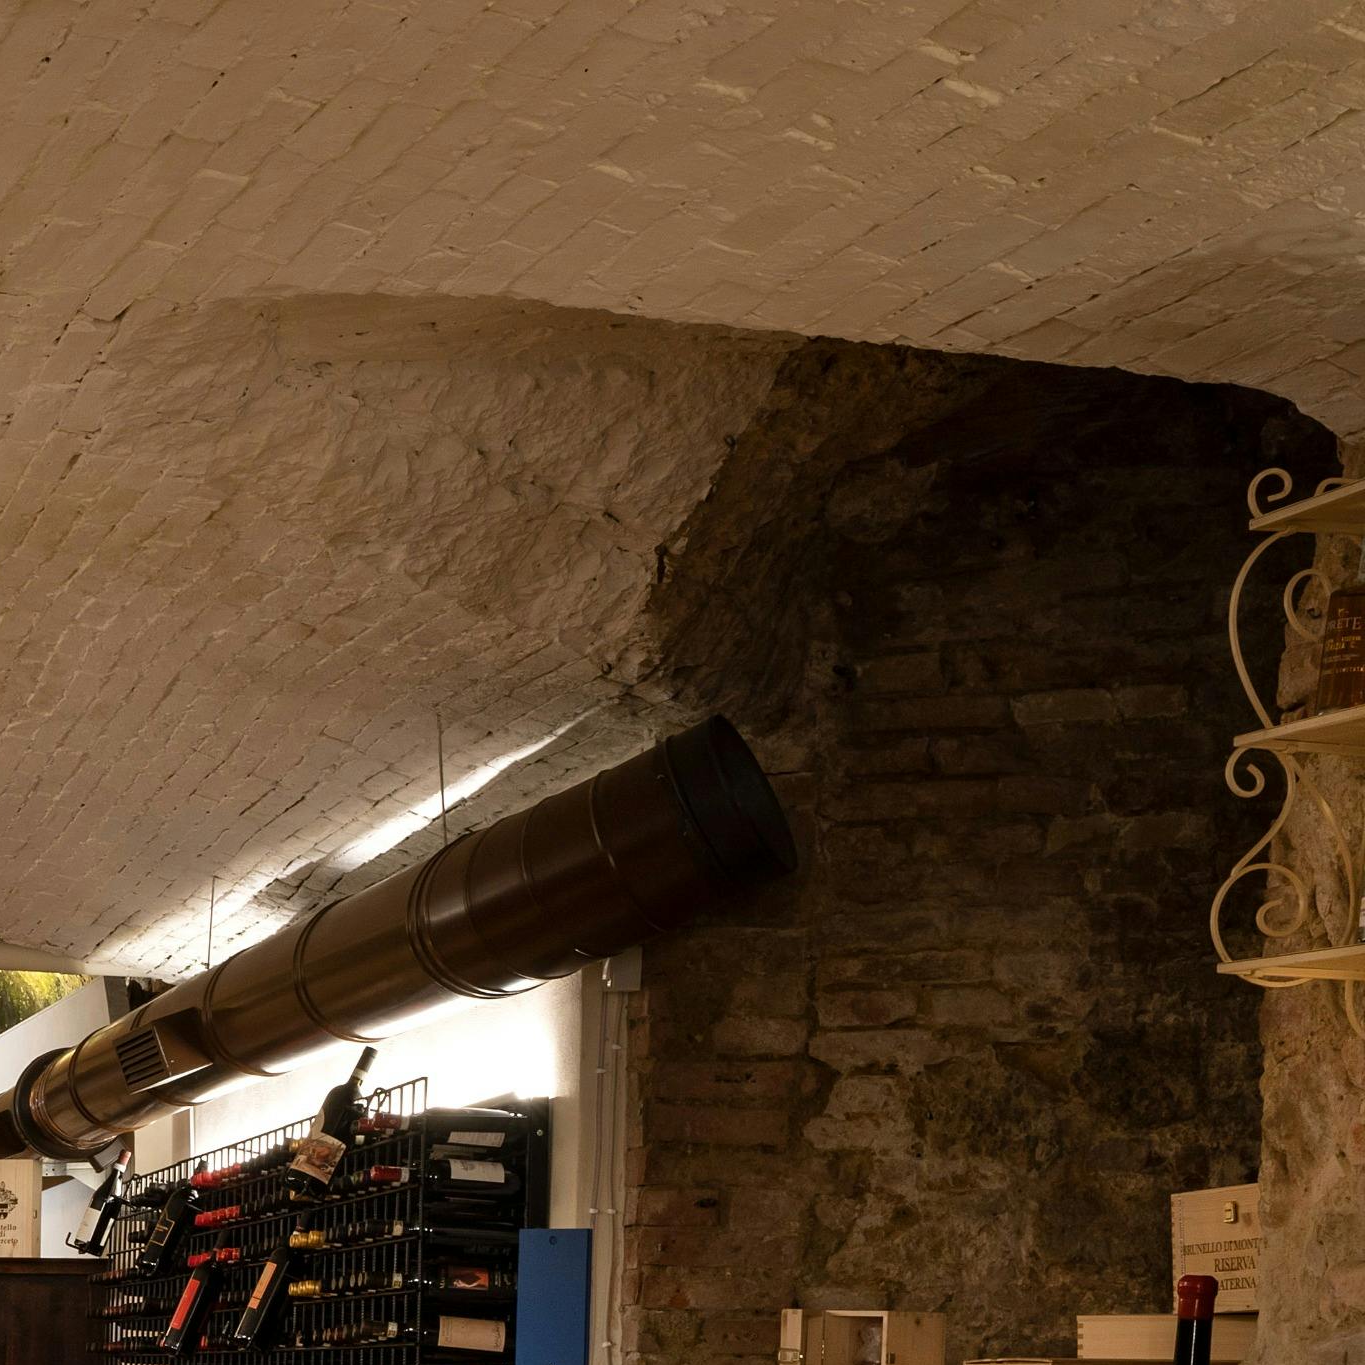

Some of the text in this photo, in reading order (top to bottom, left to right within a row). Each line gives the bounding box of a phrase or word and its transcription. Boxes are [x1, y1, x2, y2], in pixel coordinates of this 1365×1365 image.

[1182, 1241, 1223, 1256] BRUNELLO
[1213, 1255, 1257, 1273] RISERVA
[1219, 1276, 1257, 1291] ATERINA
